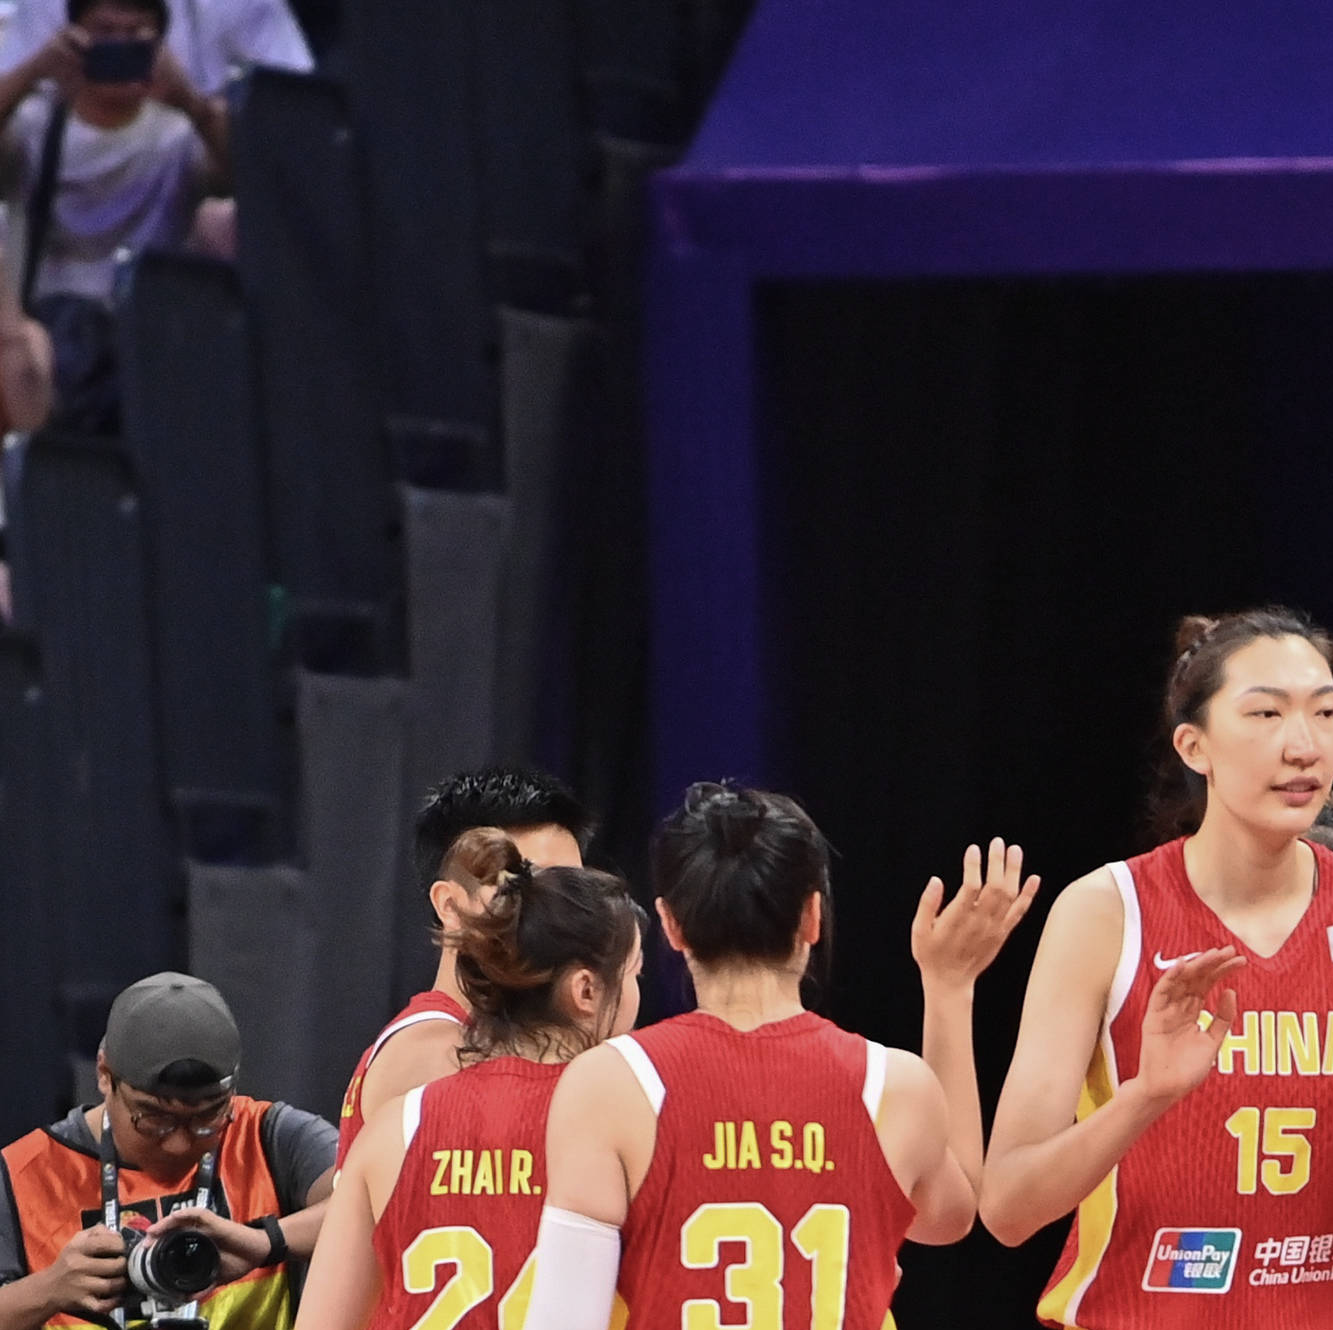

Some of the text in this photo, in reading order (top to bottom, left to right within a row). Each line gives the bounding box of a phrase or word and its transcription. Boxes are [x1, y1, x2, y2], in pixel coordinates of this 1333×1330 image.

[703, 1120, 835, 1173] JIA S.Q.
[1225, 1107, 1316, 1196] 15
[430, 1148, 542, 1195] ZHAI R.
[1157, 1244, 1230, 1266] UnionPay
[1249, 1268, 1289, 1287] China
